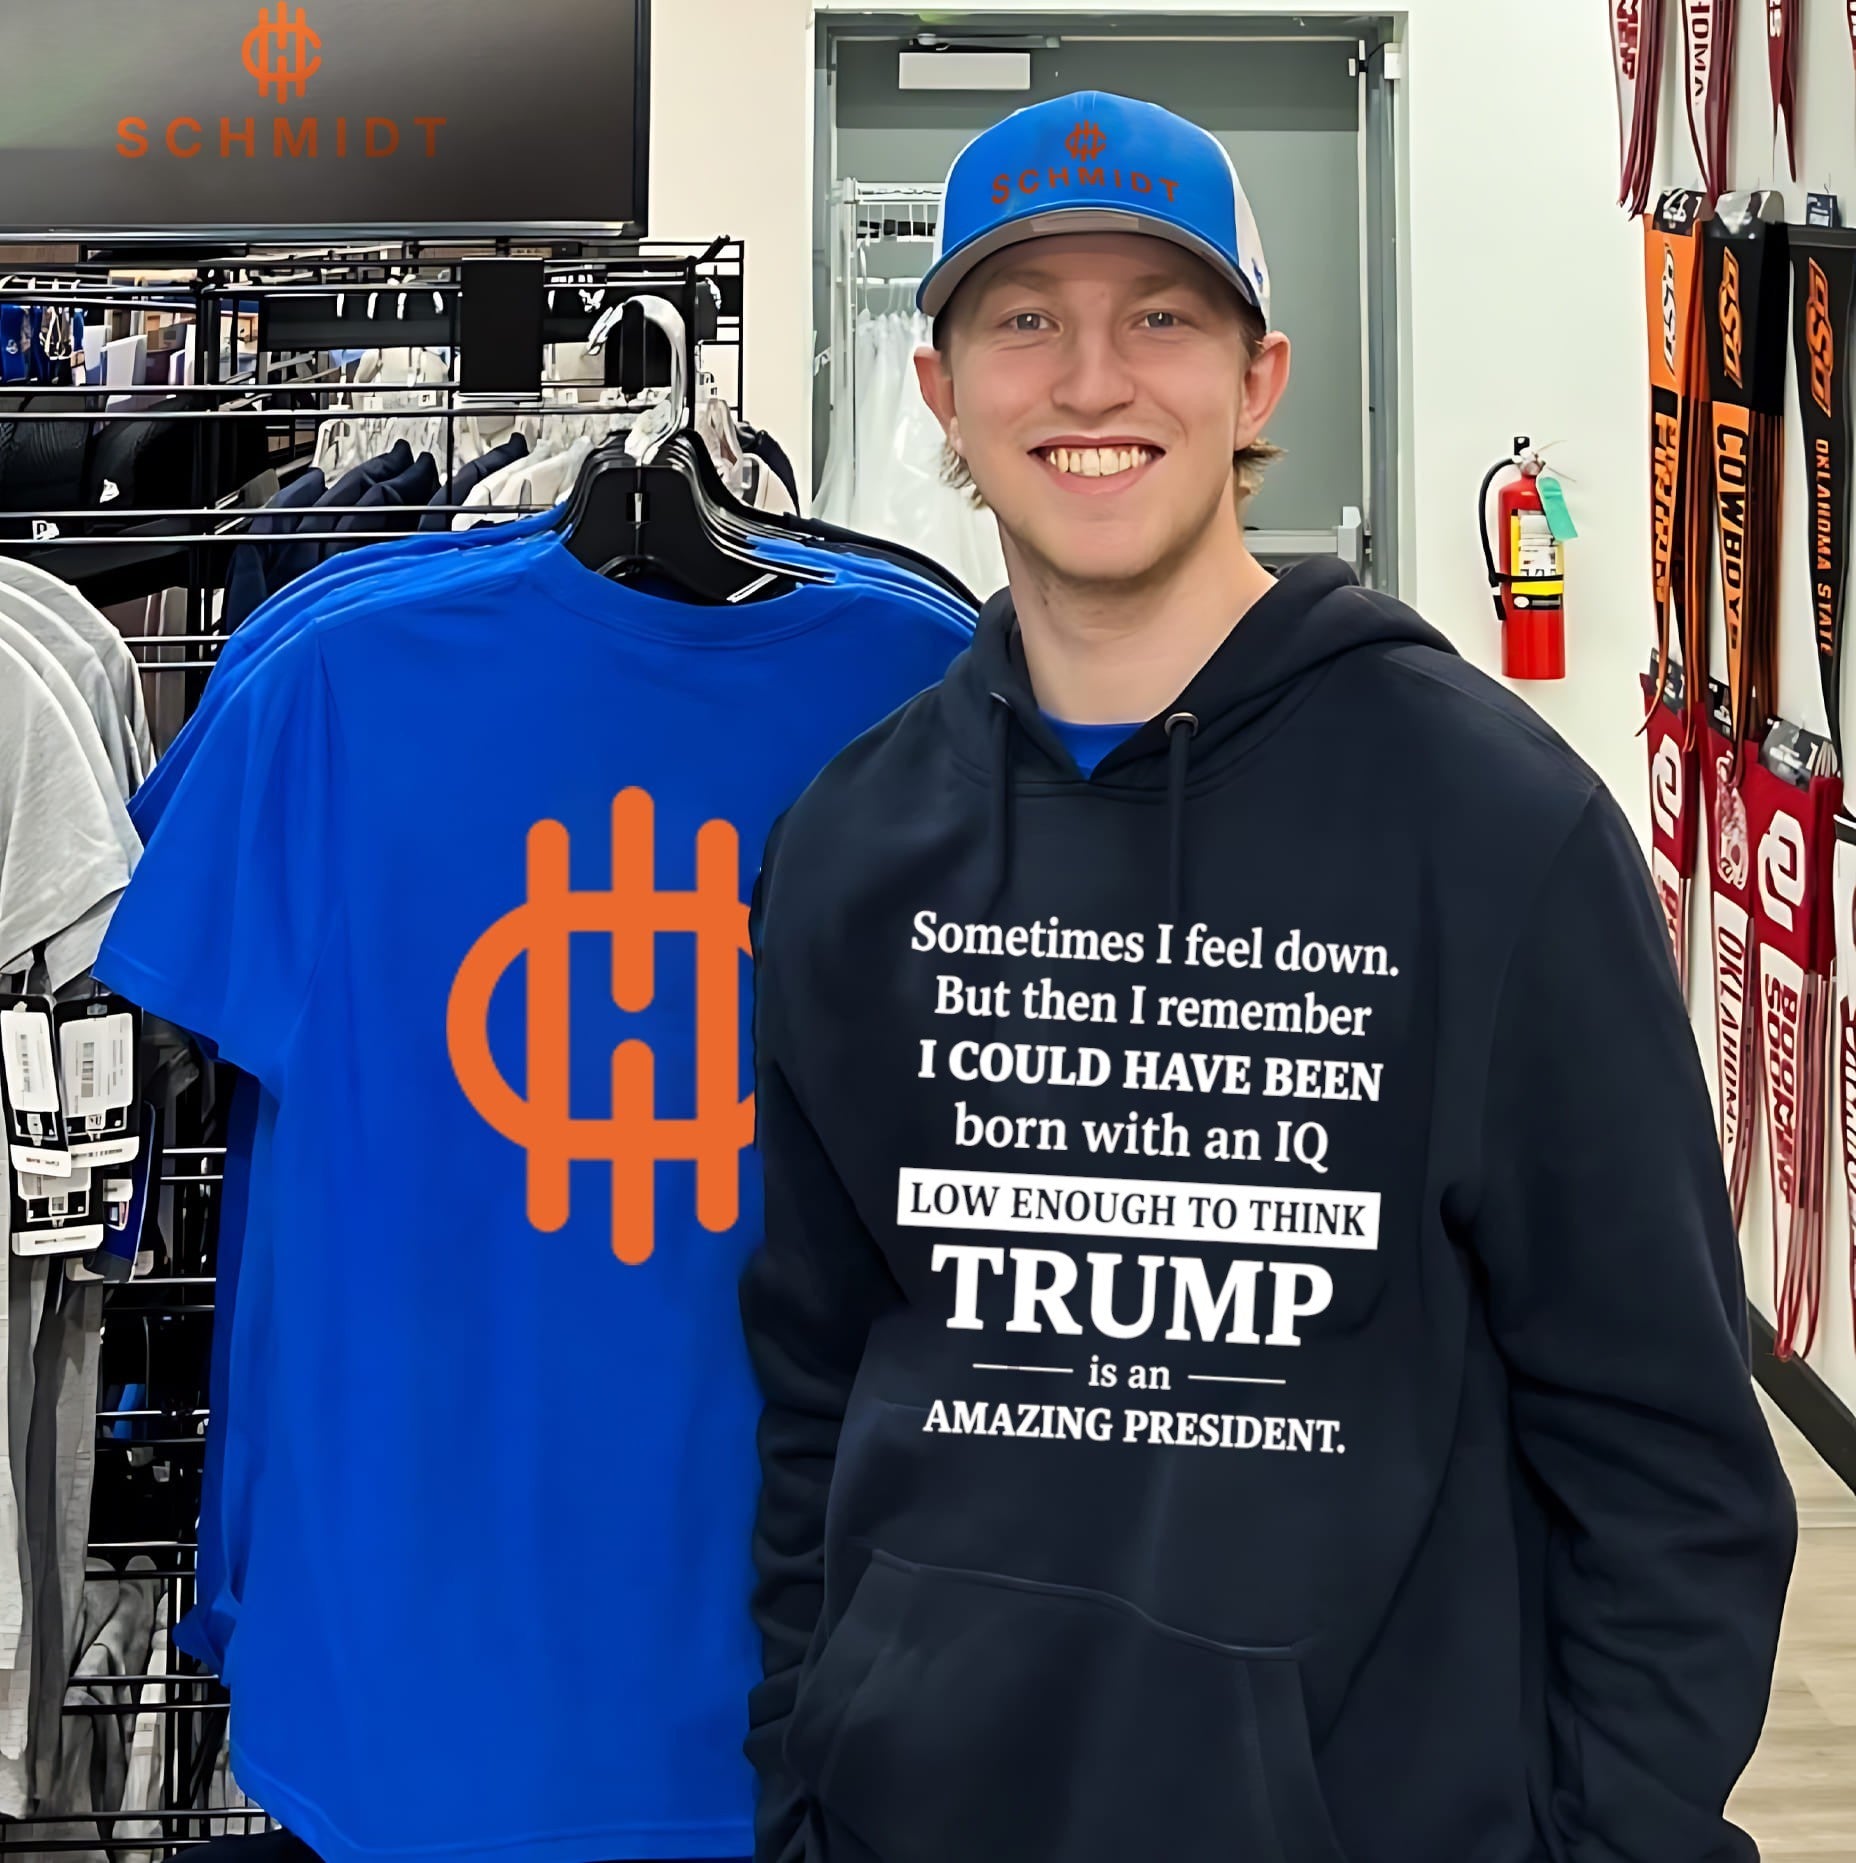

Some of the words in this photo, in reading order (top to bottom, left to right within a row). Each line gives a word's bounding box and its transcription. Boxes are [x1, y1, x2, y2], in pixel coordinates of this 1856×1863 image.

[115, 116, 448, 159] SCHMIDT
[991, 166, 1180, 204] SCHMIDT
[1814, 438, 1833, 570] OKLAHOMA
[912, 911, 1144, 962] Sometimes
[1157, 924, 1173, 963] I
[1185, 923, 1262, 968] feel
[1275, 929, 1398, 976] down.
[935, 975, 1010, 1017] But
[1023, 978, 1117, 1022] then
[1130, 986, 1146, 1024] I
[1157, 992, 1372, 1035] remember
[1718, 926, 1744, 1144] OKLAHOMA
[918, 1040, 936, 1078] I
[949, 1041, 1110, 1086] COULD
[1123, 1050, 1250, 1094] HAVE
[1263, 1058, 1383, 1101] BEEN
[955, 1102, 1067, 1150] born
[1082, 1111, 1190, 1156] with
[1205, 1128, 1261, 1160] an
[1275, 1121, 1328, 1173] IQ
[911, 1183, 999, 1216] LOW
[1011, 1188, 1175, 1225] ENOUGH
[1189, 1198, 1236, 1228] TO
[1250, 1201, 1364, 1235] THINK
[931, 1244, 1334, 1346] TRUMP
[1089, 1355, 1117, 1387] is
[1128, 1366, 1170, 1390] an
[923, 1400, 1113, 1441] AMAZING
[1123, 1410, 1345, 1453] PRESIDENT.
